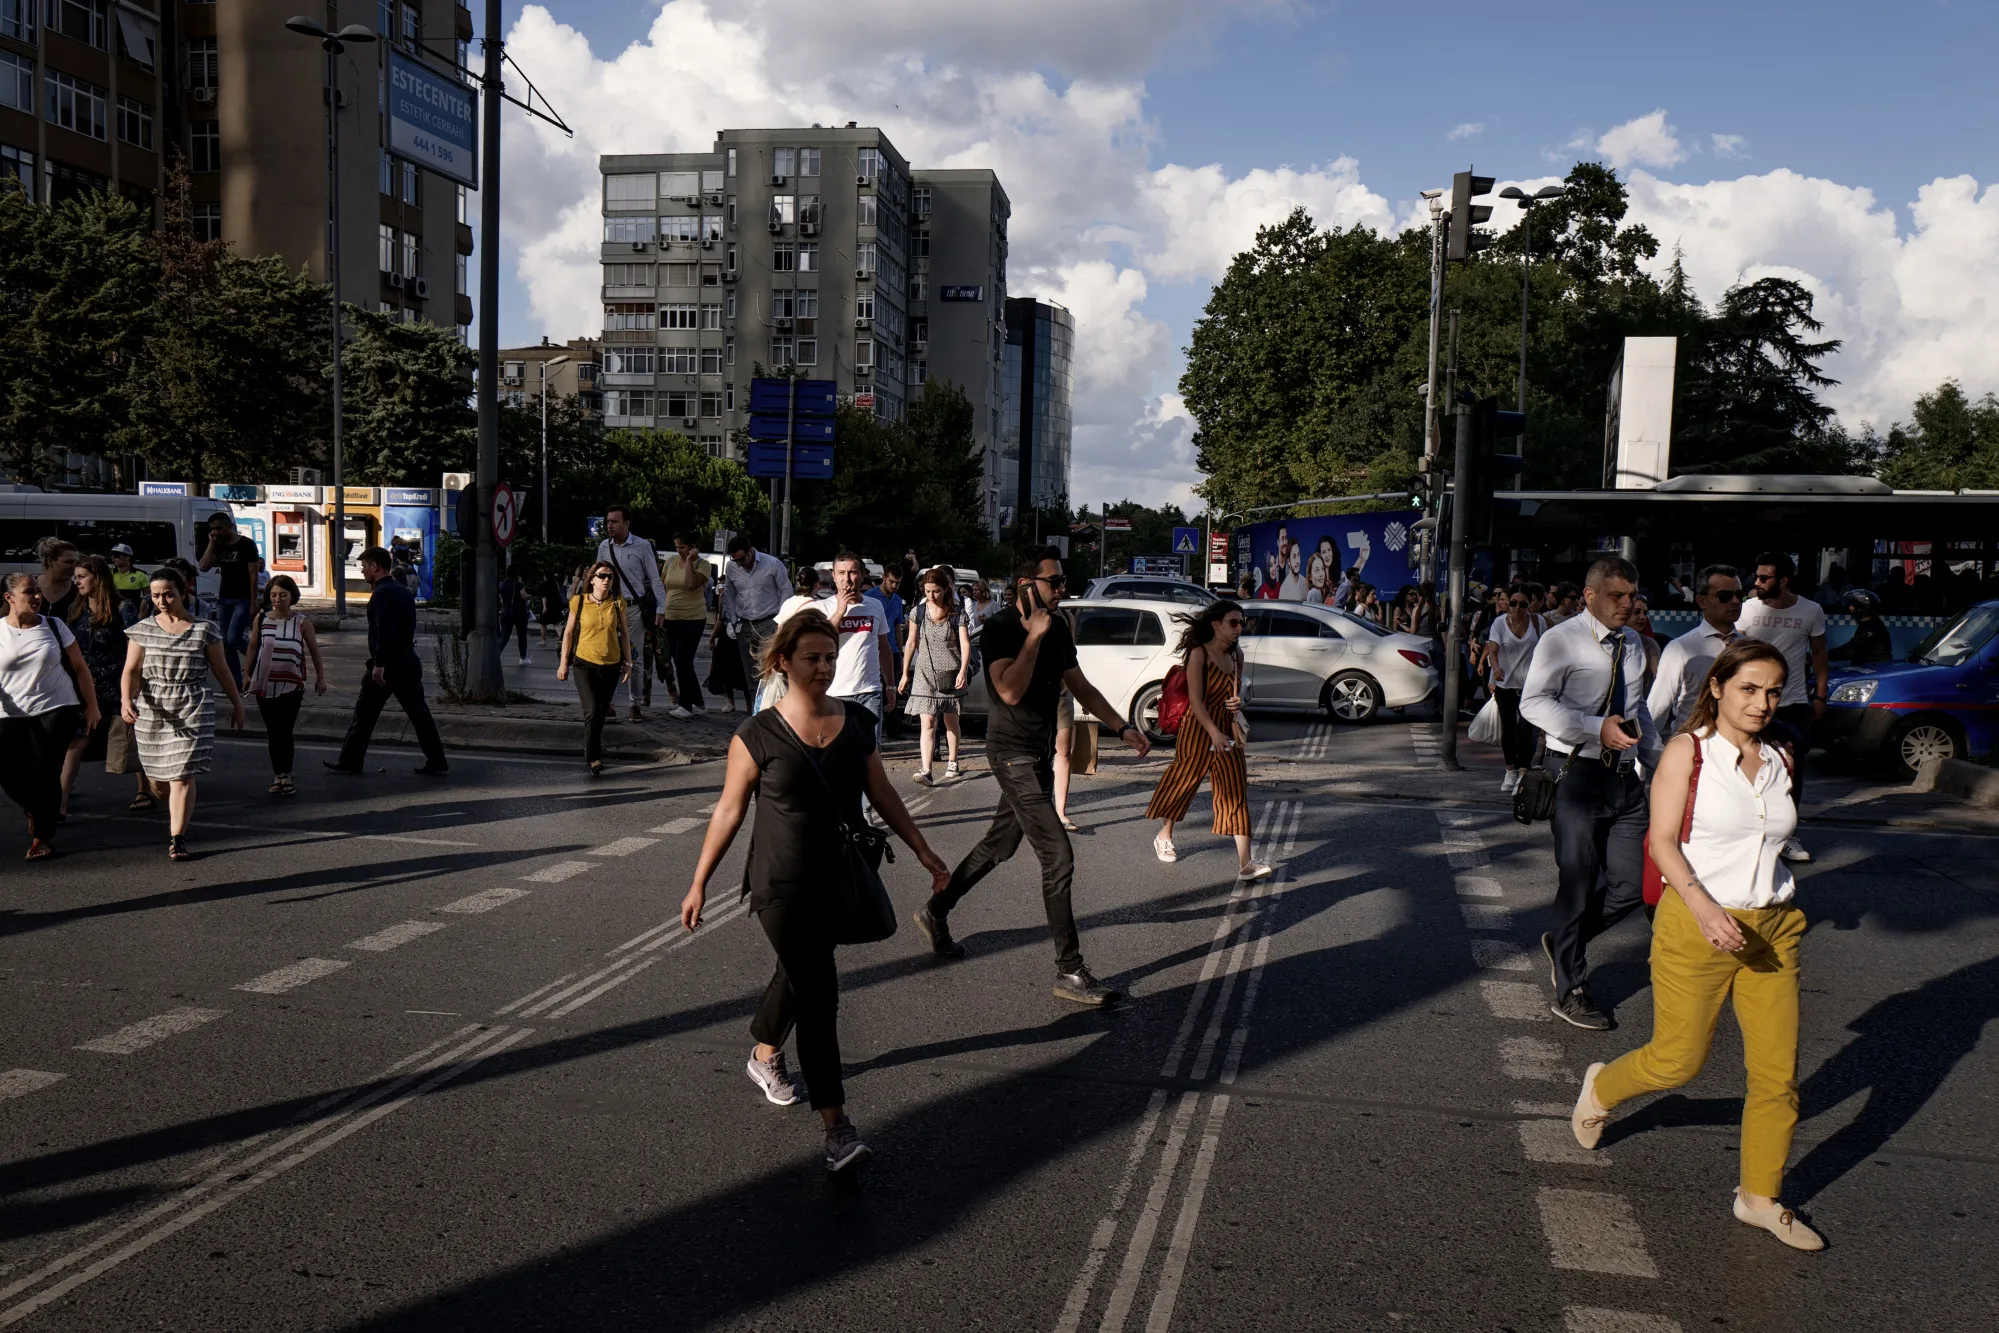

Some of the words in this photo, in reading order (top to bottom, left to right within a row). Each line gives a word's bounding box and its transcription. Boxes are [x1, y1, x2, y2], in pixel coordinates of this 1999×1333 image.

[392, 66, 472, 123] ESTECENTER
[400, 99, 430, 125] ESTETİK
[432, 115, 464, 139] CERRAHİ
[413, 135, 429, 152] 444
[431, 143, 436, 155] 1
[438, 146, 453, 162] 596
[153, 487, 183, 495] HALKBANK
[1752, 615, 1803, 630] SUPER
